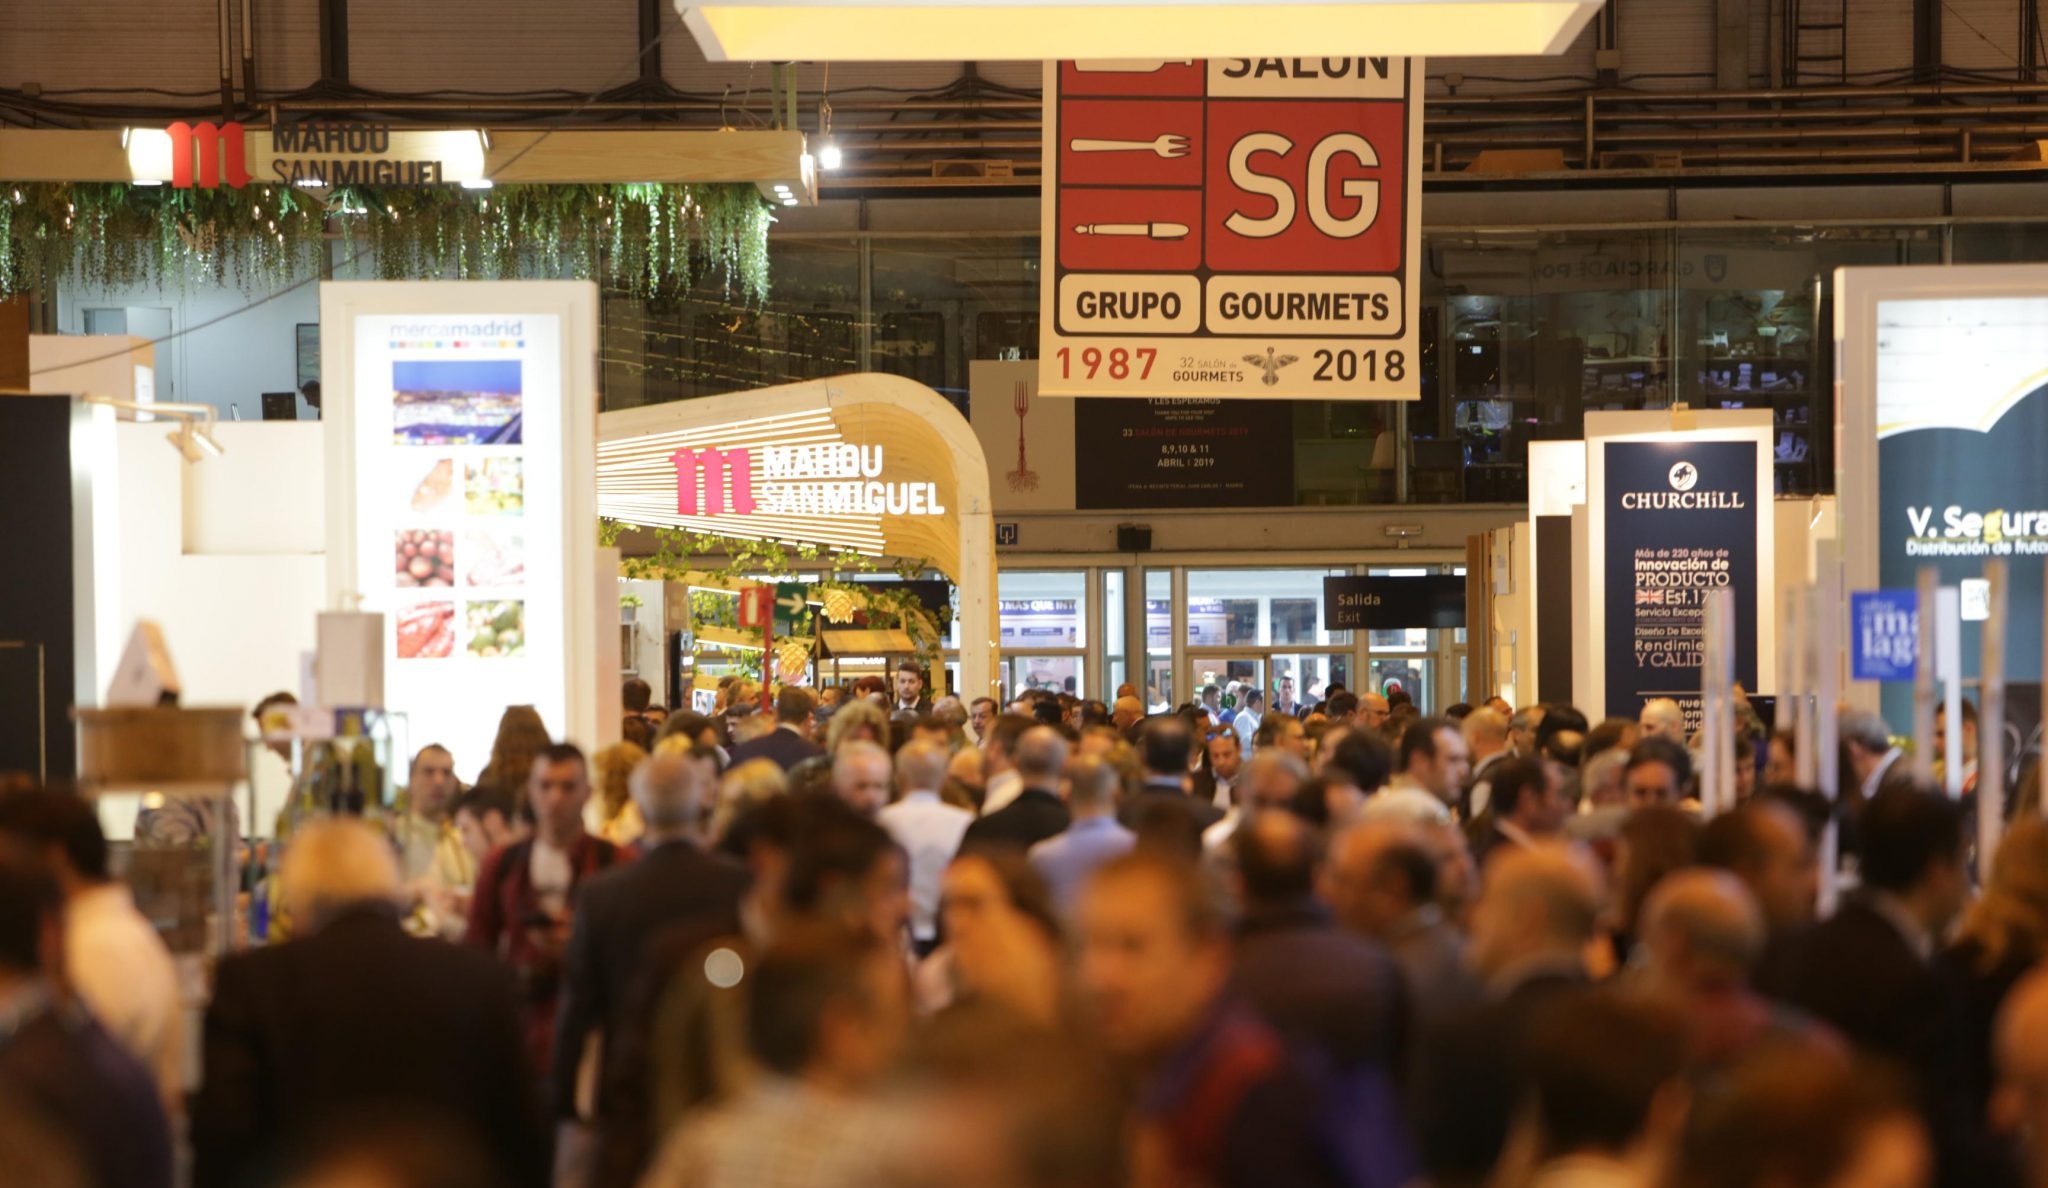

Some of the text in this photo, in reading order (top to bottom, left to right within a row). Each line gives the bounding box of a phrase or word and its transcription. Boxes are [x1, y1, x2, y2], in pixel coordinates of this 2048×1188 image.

[272, 122, 390, 153] MAHOU
[1223, 130, 1381, 240] SG
[1076, 291, 1182, 320] GRUPO
[1219, 292, 1389, 321] GOURMETS
[390, 320, 523, 336] mercamadrid
[1056, 347, 1157, 380] 1987
[1180, 356, 1194, 368] 32
[1197, 358, 1226, 369] SALÓN
[1312, 349, 1406, 382] 2018
[1172, 371, 1244, 382] GOURMETS
[1122, 428, 1133, 437] 33
[1200, 445, 1209, 453] 11
[763, 443, 882, 478] MAHOU
[1157, 458, 1185, 467] ABRIL
[1194, 458, 1214, 467] 2019
[1906, 505, 2048, 544] V. Segura
[1635, 548, 1729, 558] Más de 220 años de
[1906, 538, 1990, 556] Distribución
[1992, 540, 2012, 556] de
[1711, 558, 1729, 571] de
[1635, 571, 1730, 586] PRODUCTO
[1031, 600, 1055, 611] QUE
[1337, 593, 1381, 606] Salida
[1338, 611, 1361, 623] Exit
[1635, 607, 1671, 617] Servicio
[1635, 626, 1665, 636] Diseño
[1667, 627, 1680, 636] De
[1635, 640, 1705, 652] Rendimie
[1635, 652, 1705, 667] Y CALID
